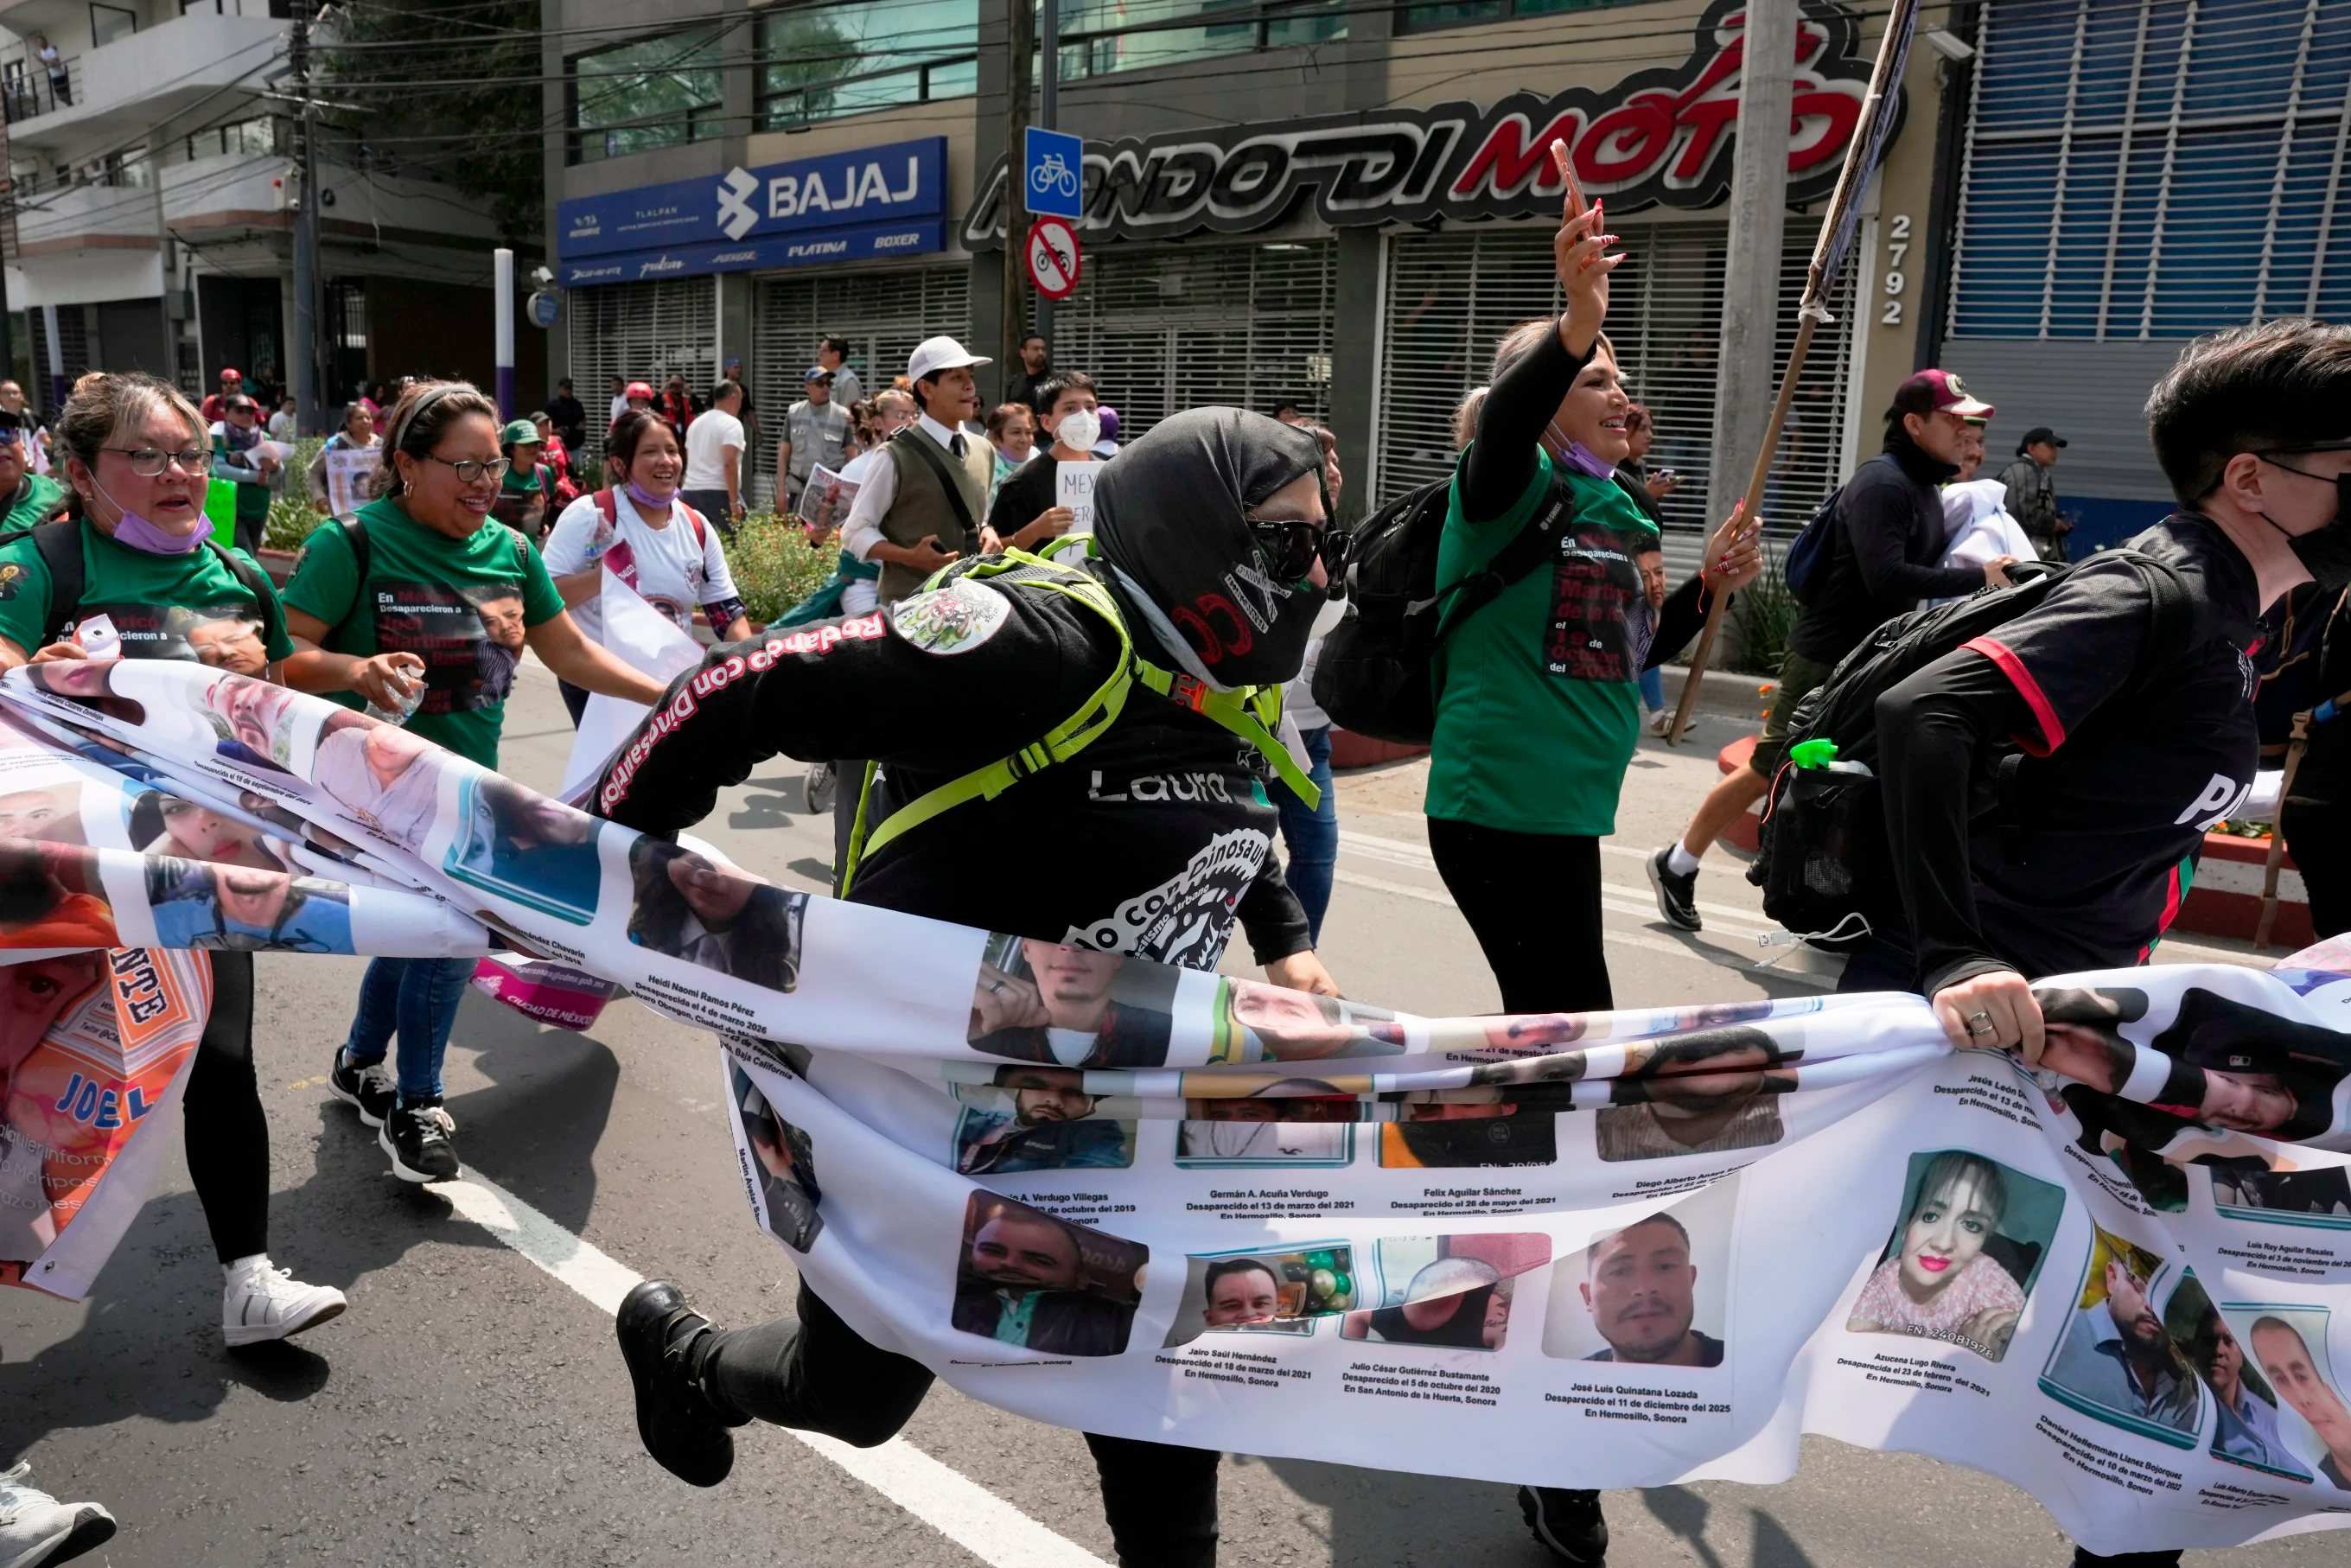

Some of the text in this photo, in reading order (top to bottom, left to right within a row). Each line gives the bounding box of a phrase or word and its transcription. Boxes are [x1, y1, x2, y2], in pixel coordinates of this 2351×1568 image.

[1453, 85, 1862, 194] MOTO
[768, 156, 919, 219] BAJAJ
[635, 207, 678, 219] TLALPAN
[788, 240, 847, 258] PLATINA
[874, 233, 919, 250] BOXER
[1561, 536, 1576, 548] En
[1563, 550, 1624, 561] Desaparecieron
[378, 592, 393, 603] En
[379, 605, 453, 614] Desaparecieron
[1590, 640, 1602, 649] de
[1550, 663, 1565, 673] del
[601, 612, 884, 817] Rodando con Dinosaurios
[1088, 770, 1233, 803] Laura
[1173, 884, 1209, 915] Urbano
[634, 982, 745, 1027] Desaparecida marzo
[648, 974, 755, 1017] Heidi Naomi Ramos Pérez
[507, 995, 545, 1015] CIUDAD
[545, 1007, 560, 1018] DE
[558, 1010, 593, 1024] MÉXICO
[753, 1056, 793, 1080] California
[1968, 1075, 1993, 1087] Jesús
[1934, 1085, 1987, 1097] Desaparecido
[55, 1072, 155, 1129] JOEL
[1970, 1098, 2018, 1123] Hermosillo,
[1664, 1175, 1696, 1185] Alberto
[1032, 1193, 1108, 1202] Verdugo Villegas
[1210, 1190, 1246, 1199] Germán
[1290, 1189, 1328, 1199] Verdugo
[1424, 1188, 1521, 1198] Felix Aguilar Sánchez
[1061, 1205, 1096, 1214] octubre
[1187, 1202, 1248, 1211] Desaparecido
[1334, 1201, 1354, 1209] 2021
[2218, 1248, 2329, 1266] Desaparecido noviembre
[2278, 1245, 2334, 1256] Aguilar Rosales
[2258, 1263, 2298, 1273] Hermosillo,
[1932, 1329, 1995, 1360] 24081978
[1211, 1349, 1230, 1358] Saúl
[1232, 1352, 1277, 1364] Hernández
[1874, 1353, 1956, 1372] Azucena Lugo Rivera
[1155, 1355, 1212, 1367] Desaparecido
[1236, 1363, 1246, 1372] de
[1277, 1368, 1290, 1377] del
[1292, 1370, 1311, 1379] 2021
[1350, 1362, 1489, 1381] Julio César Gutiérrez Bustamante
[1837, 1358, 1952, 1381] Desaparecida febrero
[1185, 1369, 1279, 1387] En Hermosillo, Sonora
[1342, 1373, 1399, 1386] Desaparecido
[1401, 1378, 1409, 1386] el
[1430, 1381, 1463, 1392] octubre
[1480, 1386, 1500, 1394] 2020
[1879, 1375, 1953, 1393] Hermosillo, Sonora
[1358, 1386, 1374, 1394] San
[1375, 1387, 1409, 1398] Antonio
[1432, 1393, 1463, 1404] Huerta,
[1465, 1396, 1496, 1406] Sonora
[1571, 1383, 1698, 1399] José Luis Quinatana Lozada
[1545, 1393, 1731, 1412] Desaparecido el de diciembre del 2025
[1585, 1408, 1687, 1424] En Hermosillo, Sonora
[2036, 1423, 2152, 1482] Desaparecido marzo
[2040, 1415, 2182, 1480] Daniel Hellemman Llanez Bojorquez
[2076, 1459, 2153, 1495] Hermosillo, Sonora
